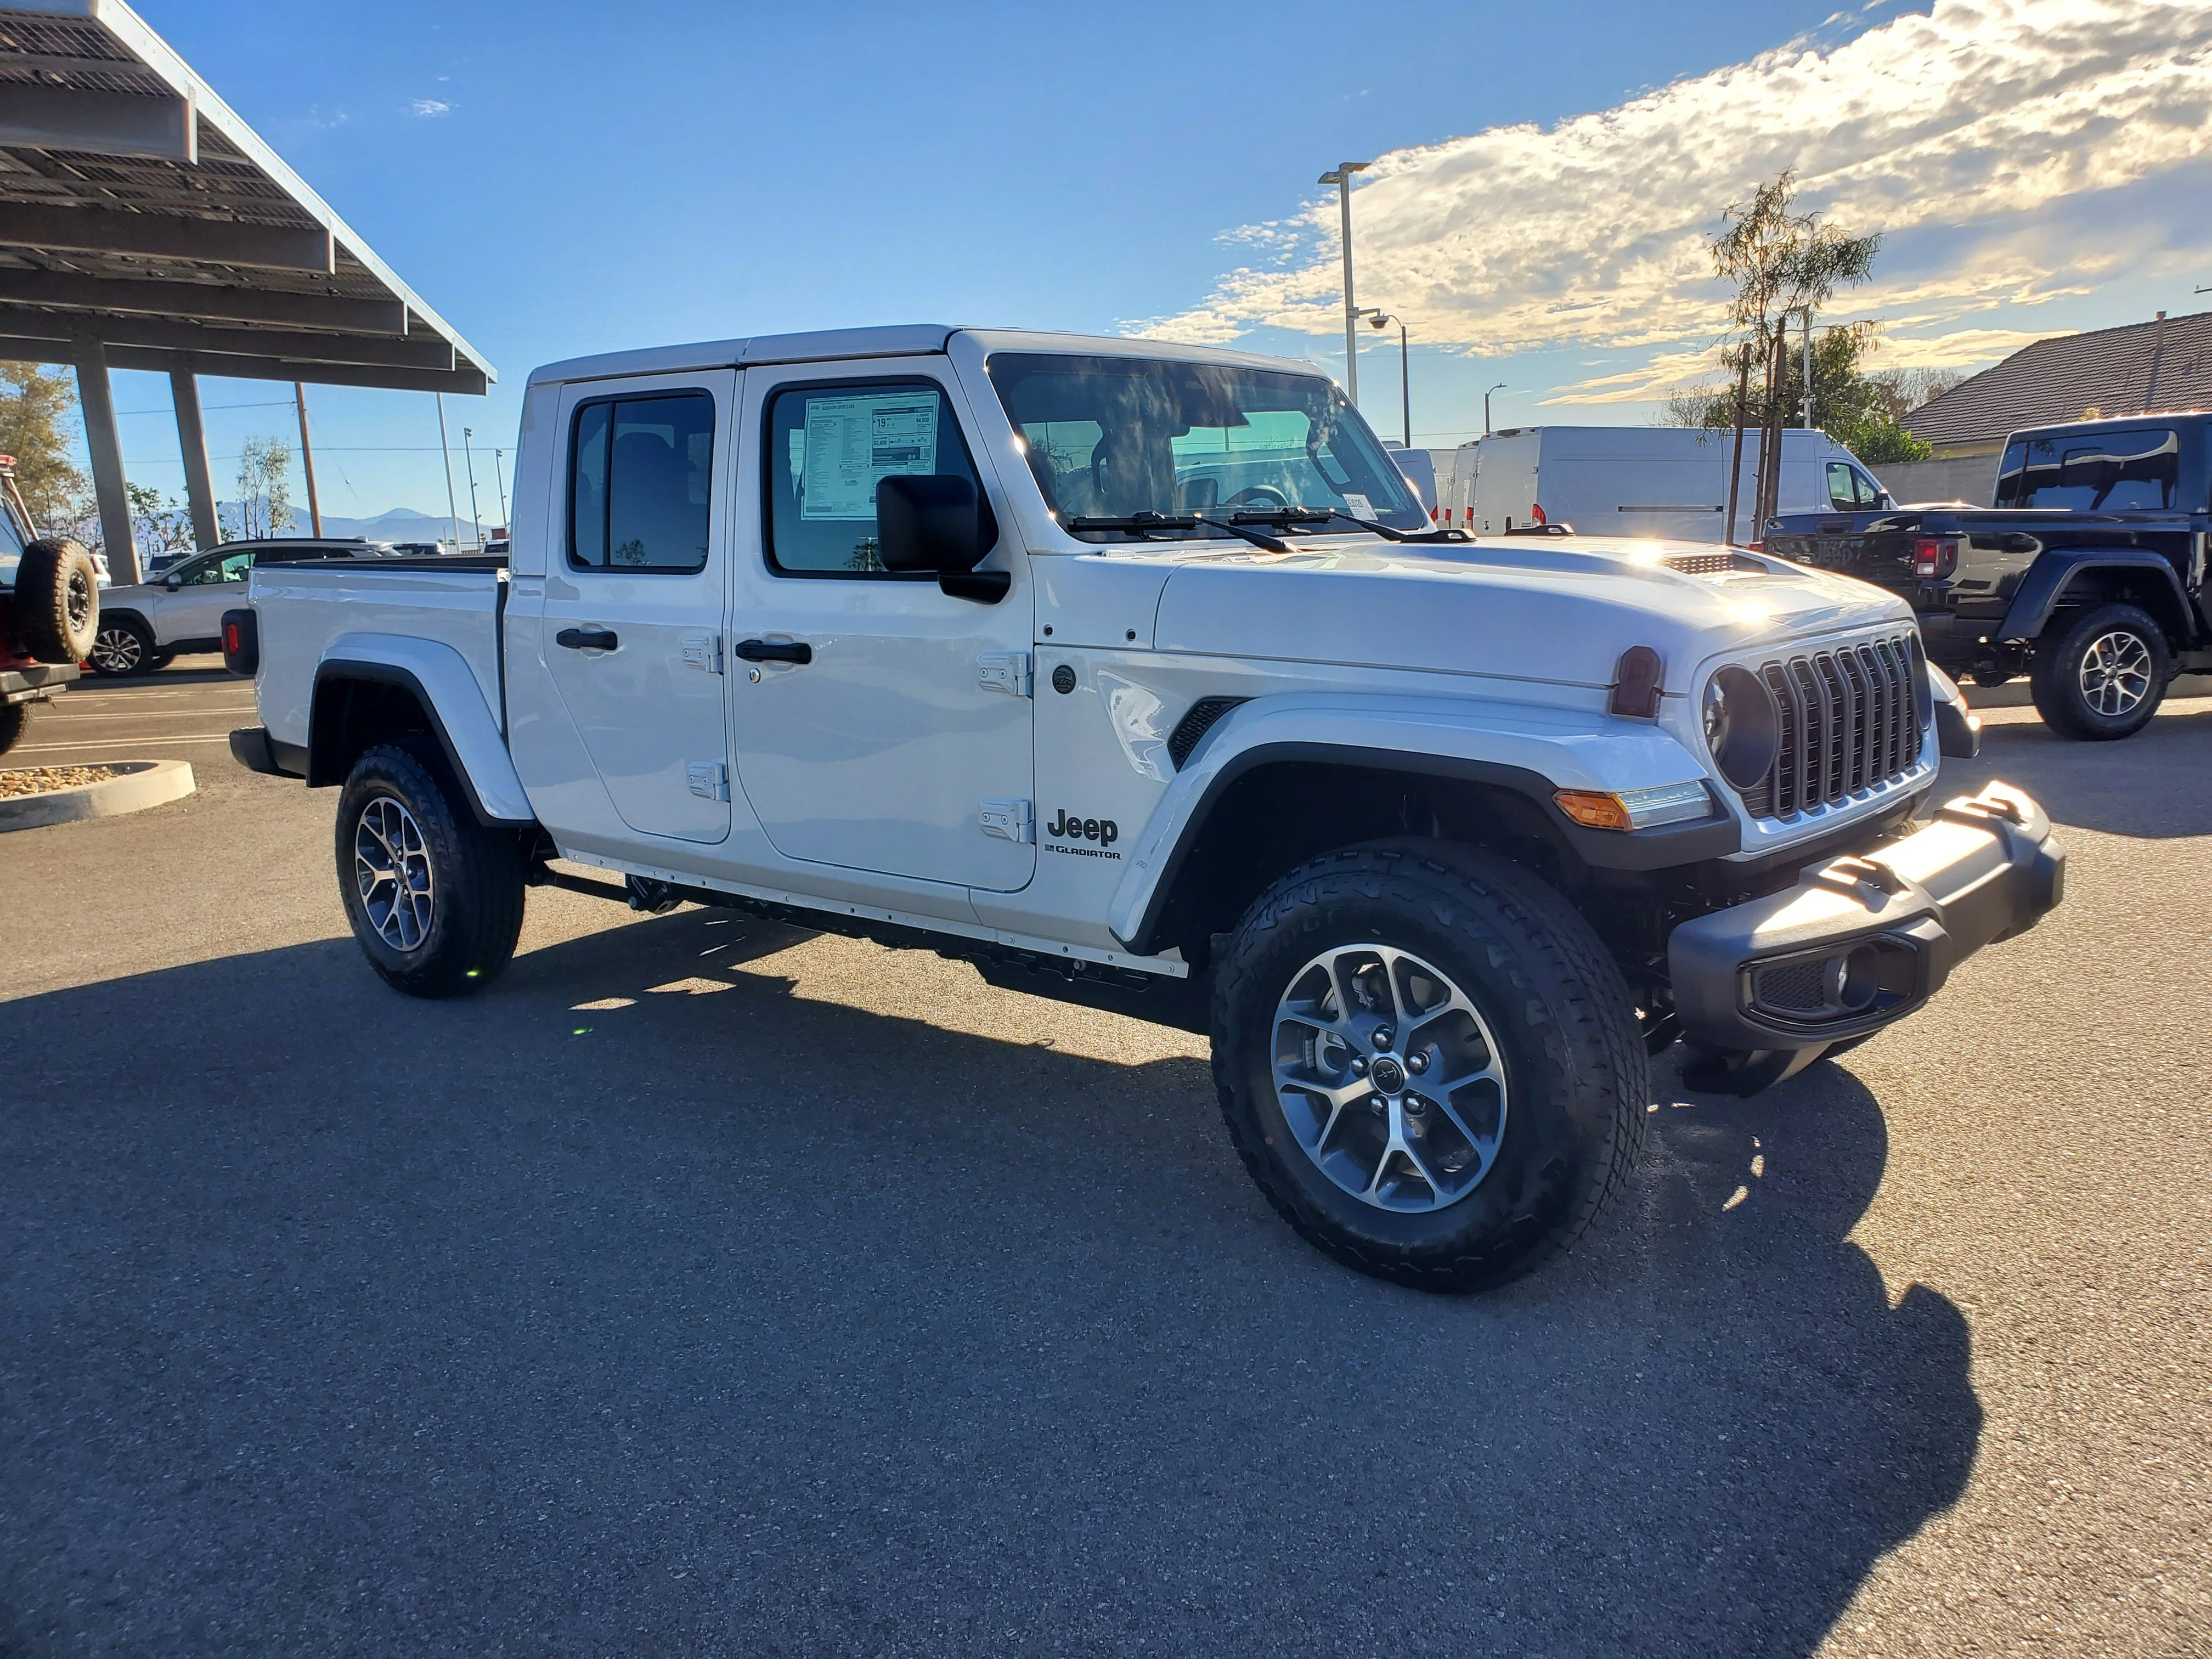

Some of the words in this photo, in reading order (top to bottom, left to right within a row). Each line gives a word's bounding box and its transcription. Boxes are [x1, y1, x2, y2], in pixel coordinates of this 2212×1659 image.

[877, 418, 886, 427] 19
[1812, 543, 1853, 567] Jeep
[1047, 809, 1118, 847] Jeep
[1056, 845, 1121, 860] GLADIATOR
